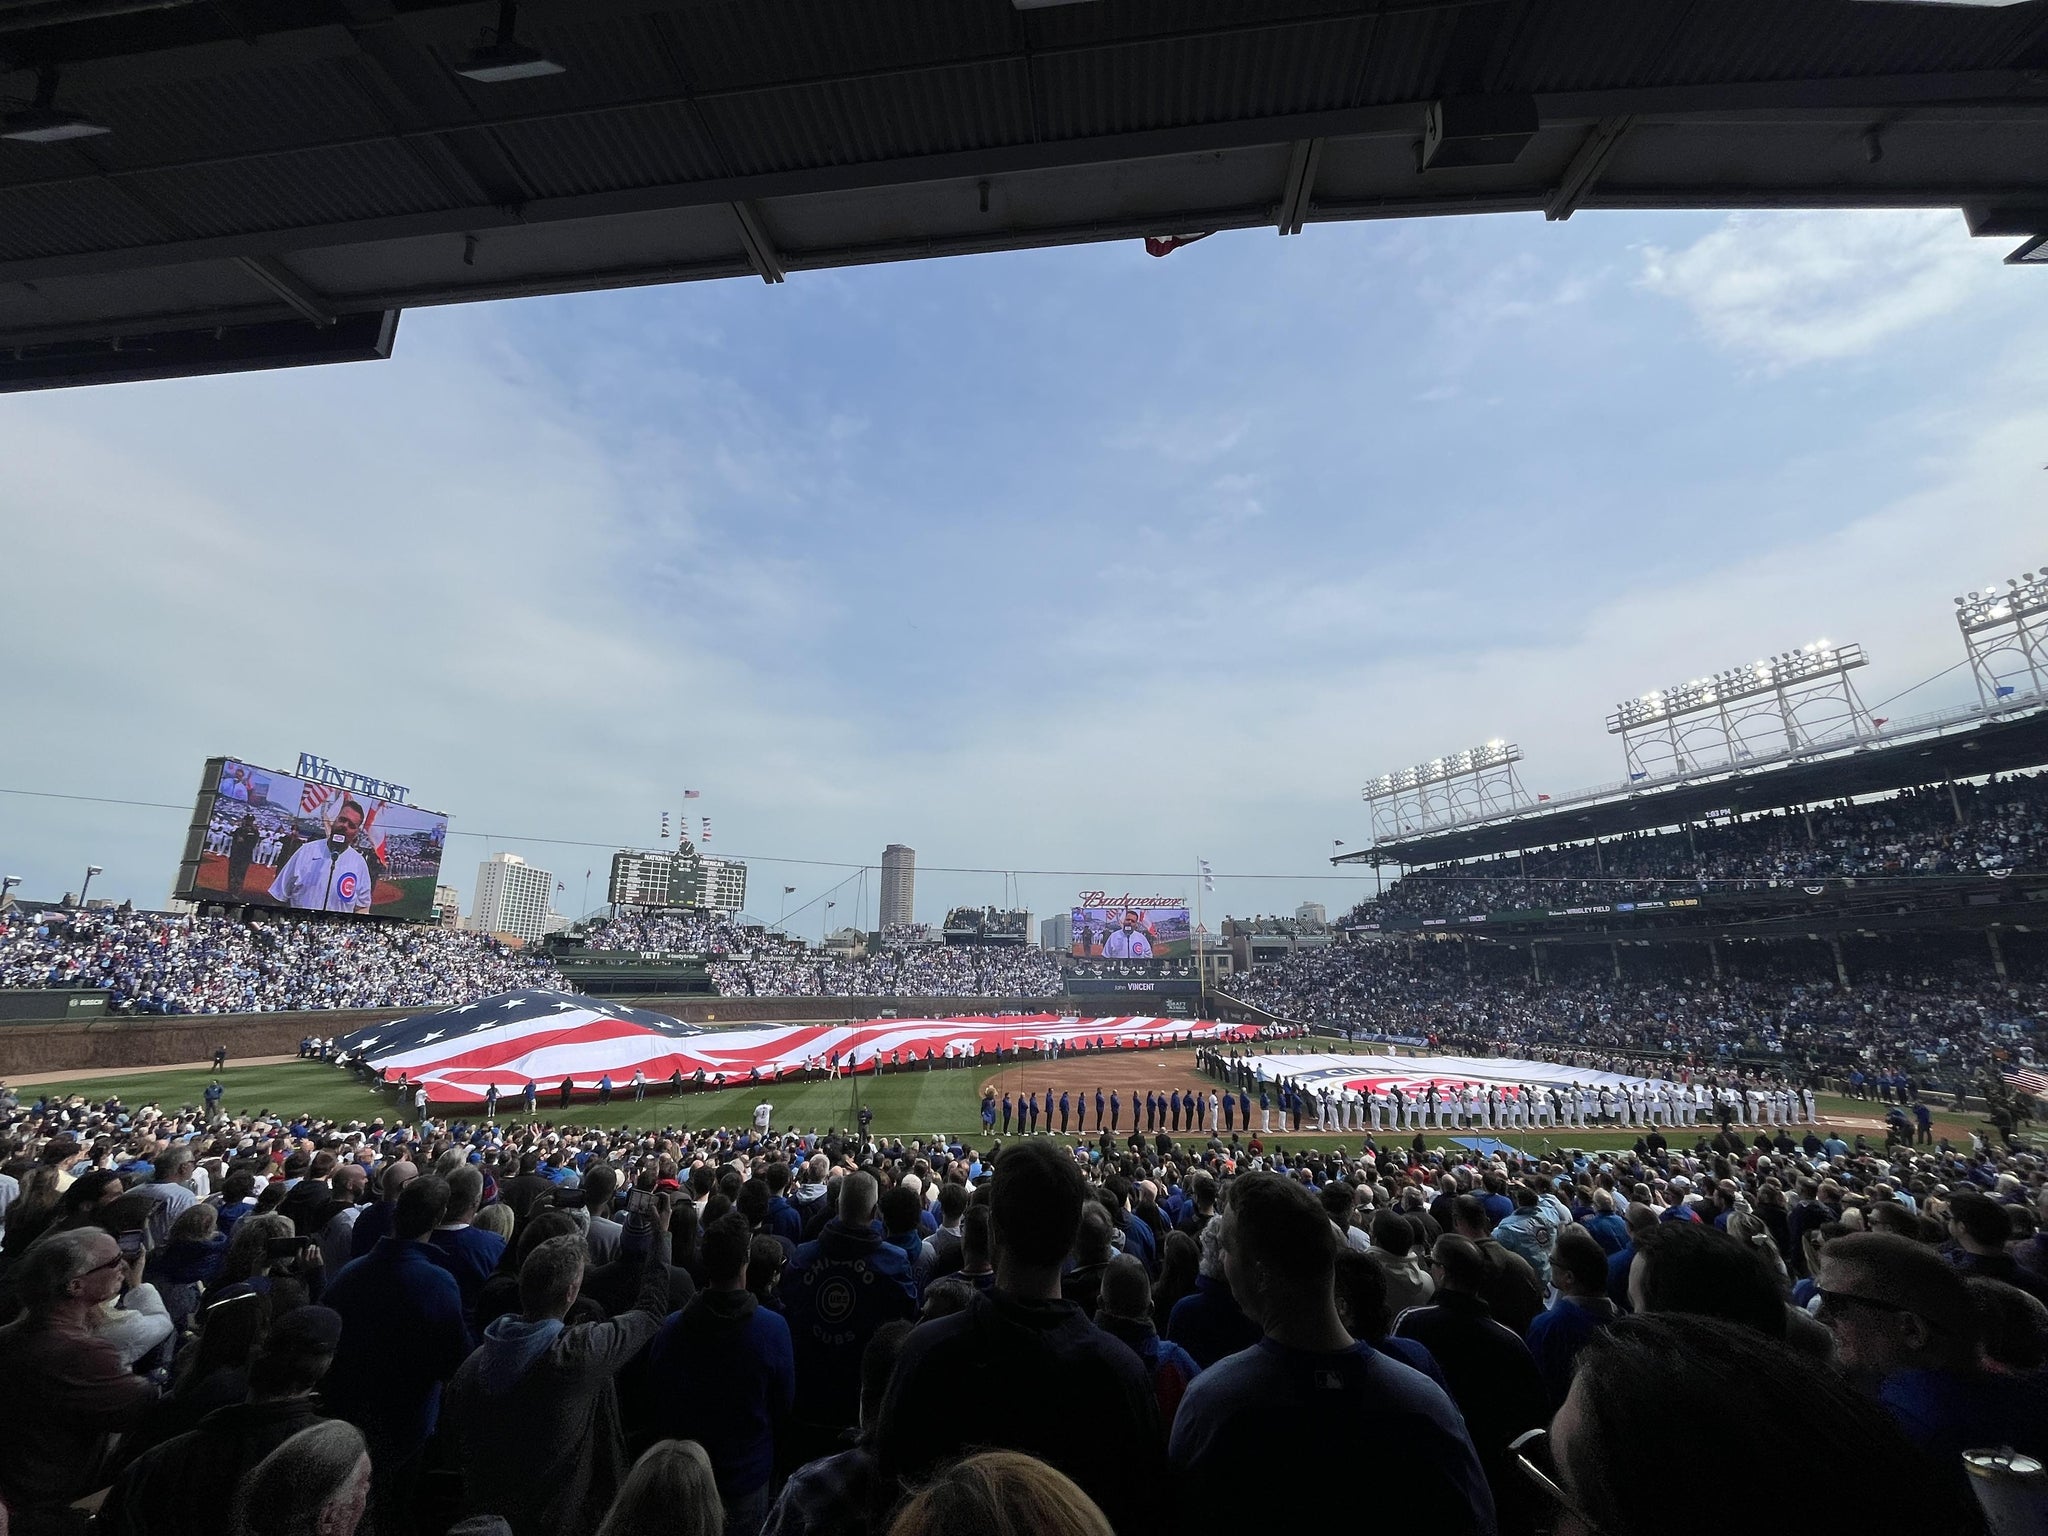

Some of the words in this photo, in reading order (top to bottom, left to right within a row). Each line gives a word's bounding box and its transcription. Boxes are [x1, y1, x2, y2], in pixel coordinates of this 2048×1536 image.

[300, 752, 409, 803] WINTRUST
[644, 854, 672, 862] NATIONAL
[1079, 891, 1182, 908] Budweiser
[1566, 907, 1592, 915] WRIGLEY
[1593, 905, 1610, 913] FIELD
[1128, 982, 1155, 991] VINCENT
[813, 1324, 856, 1344] CUBS
